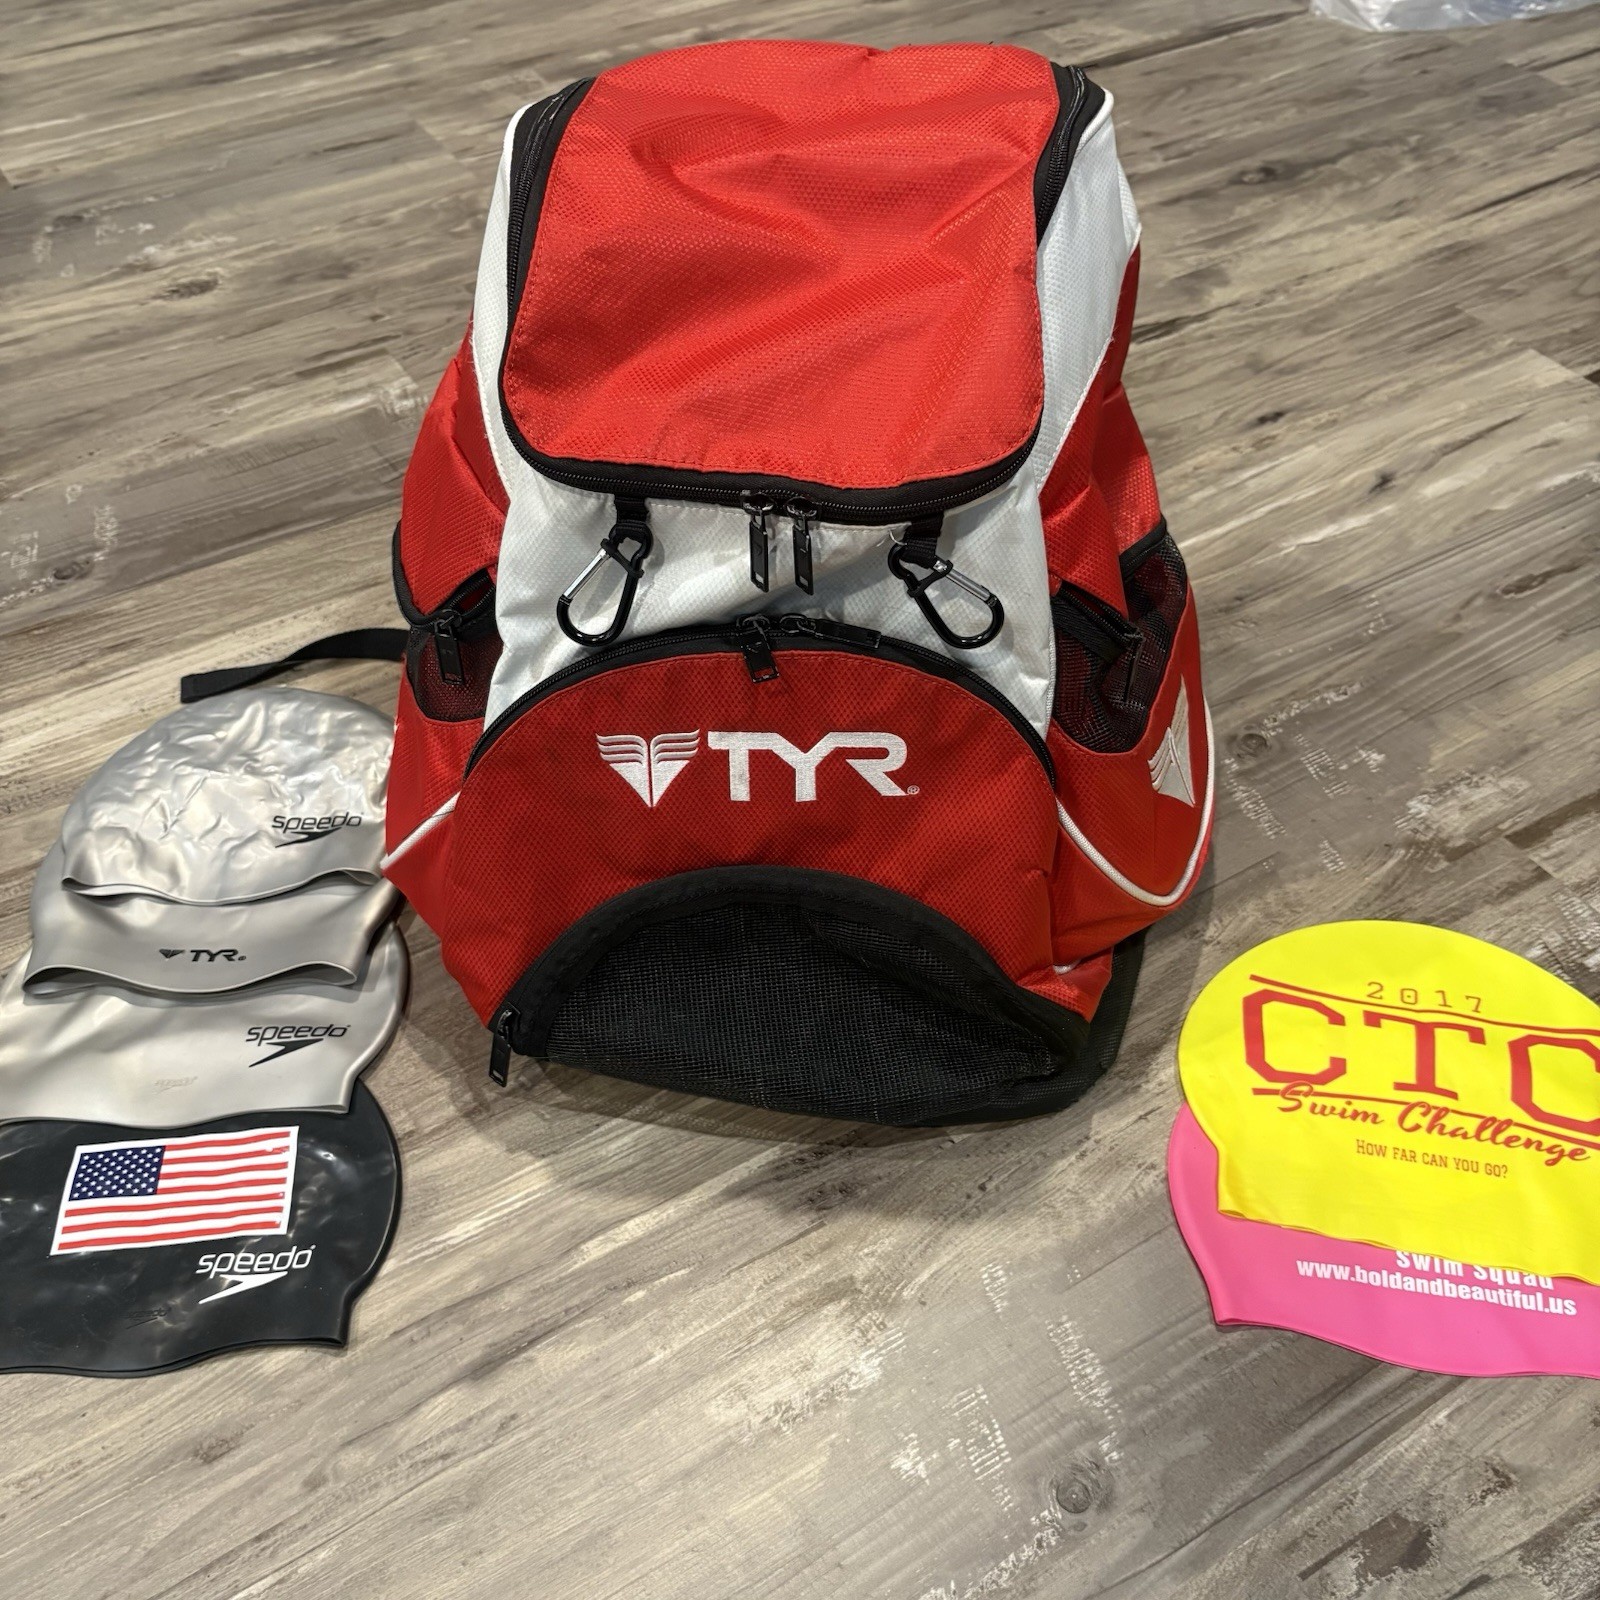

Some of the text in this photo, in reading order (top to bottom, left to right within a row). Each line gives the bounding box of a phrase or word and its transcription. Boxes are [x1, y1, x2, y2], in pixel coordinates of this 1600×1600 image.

[271, 811, 363, 832] speedo
[1366, 981, 1483, 1014] 2017
[246, 1024, 347, 1047] speedo
[1278, 1081, 1590, 1166] Swim Challenge
[196, 1246, 313, 1278] speedo
[1296, 1260, 1577, 1316] www.boldandbeautiful.us
